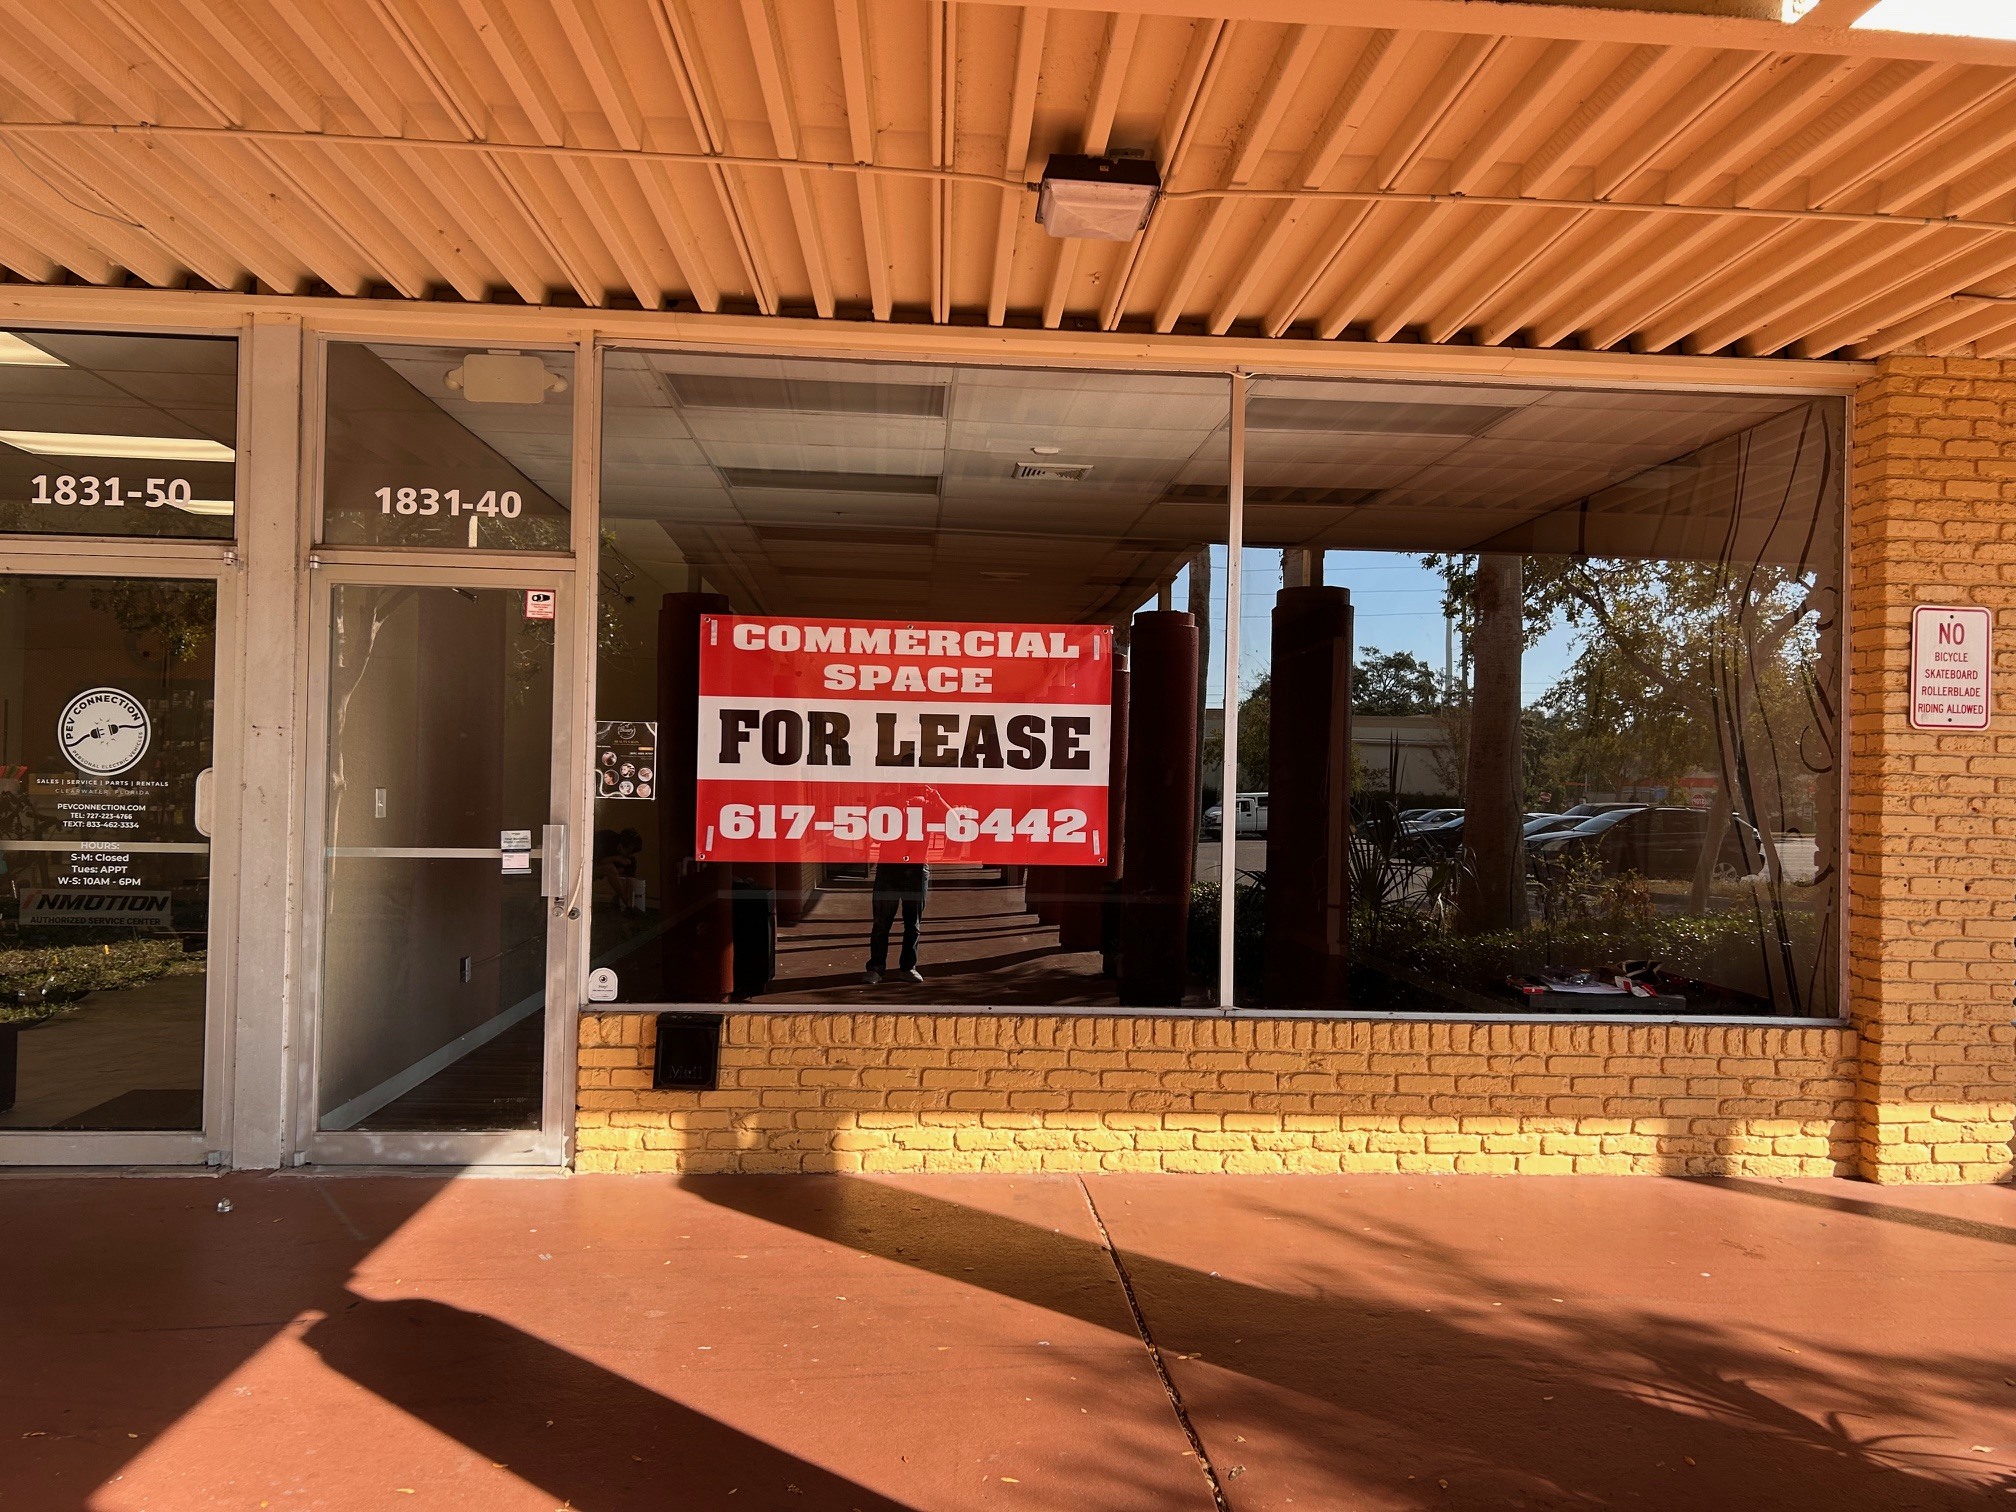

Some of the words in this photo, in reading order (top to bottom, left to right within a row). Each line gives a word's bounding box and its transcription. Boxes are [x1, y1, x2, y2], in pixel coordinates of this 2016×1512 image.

[31, 474, 192, 508] 1831-50
[374, 486, 522, 519] 1831-40
[1938, 622, 1965, 645] NO
[733, 623, 1080, 659] COMMERCIAL
[1934, 652, 1968, 662] BICYCLE
[823, 663, 993, 694] SPACE
[1924, 668, 1978, 680] SKATEBOARD
[1921, 685, 1981, 697] ROLLERBLADE
[1917, 703, 1944, 714] RIDING
[1946, 704, 1984, 715] ALLOWED
[65, 717, 76, 740] PEV
[73, 695, 141, 721] CONNECTION
[719, 708, 851, 767] FOR
[875, 712, 1091, 771] LEASE
[72, 749, 100, 769] PERSONAL
[101, 757, 129, 769] ELECTRIC
[128, 732, 143, 758] VEHICLES
[57, 803, 146, 811] PEVCONNECTION.COM
[63, 820, 85, 828] TEXT:
[86, 821, 140, 829] 833-462-3334
[719, 803, 1088, 843] 617-501-6442
[80, 841, 120, 850] HOURS:
[70, 853, 93, 861] S-M:
[95, 853, 130, 862] Closed
[71, 865, 98, 874] Tues:
[100, 865, 128, 874] APPT
[57, 876, 81, 885] W-S:
[83, 877, 110, 886] 10AM
[118, 877, 141, 886] 6PM
[22, 889, 170, 912] INMOTION
[30, 916, 87, 925] AUTHORIZED
[88, 916, 125, 925] SERVICE
[126, 917, 161, 926] CENTER
